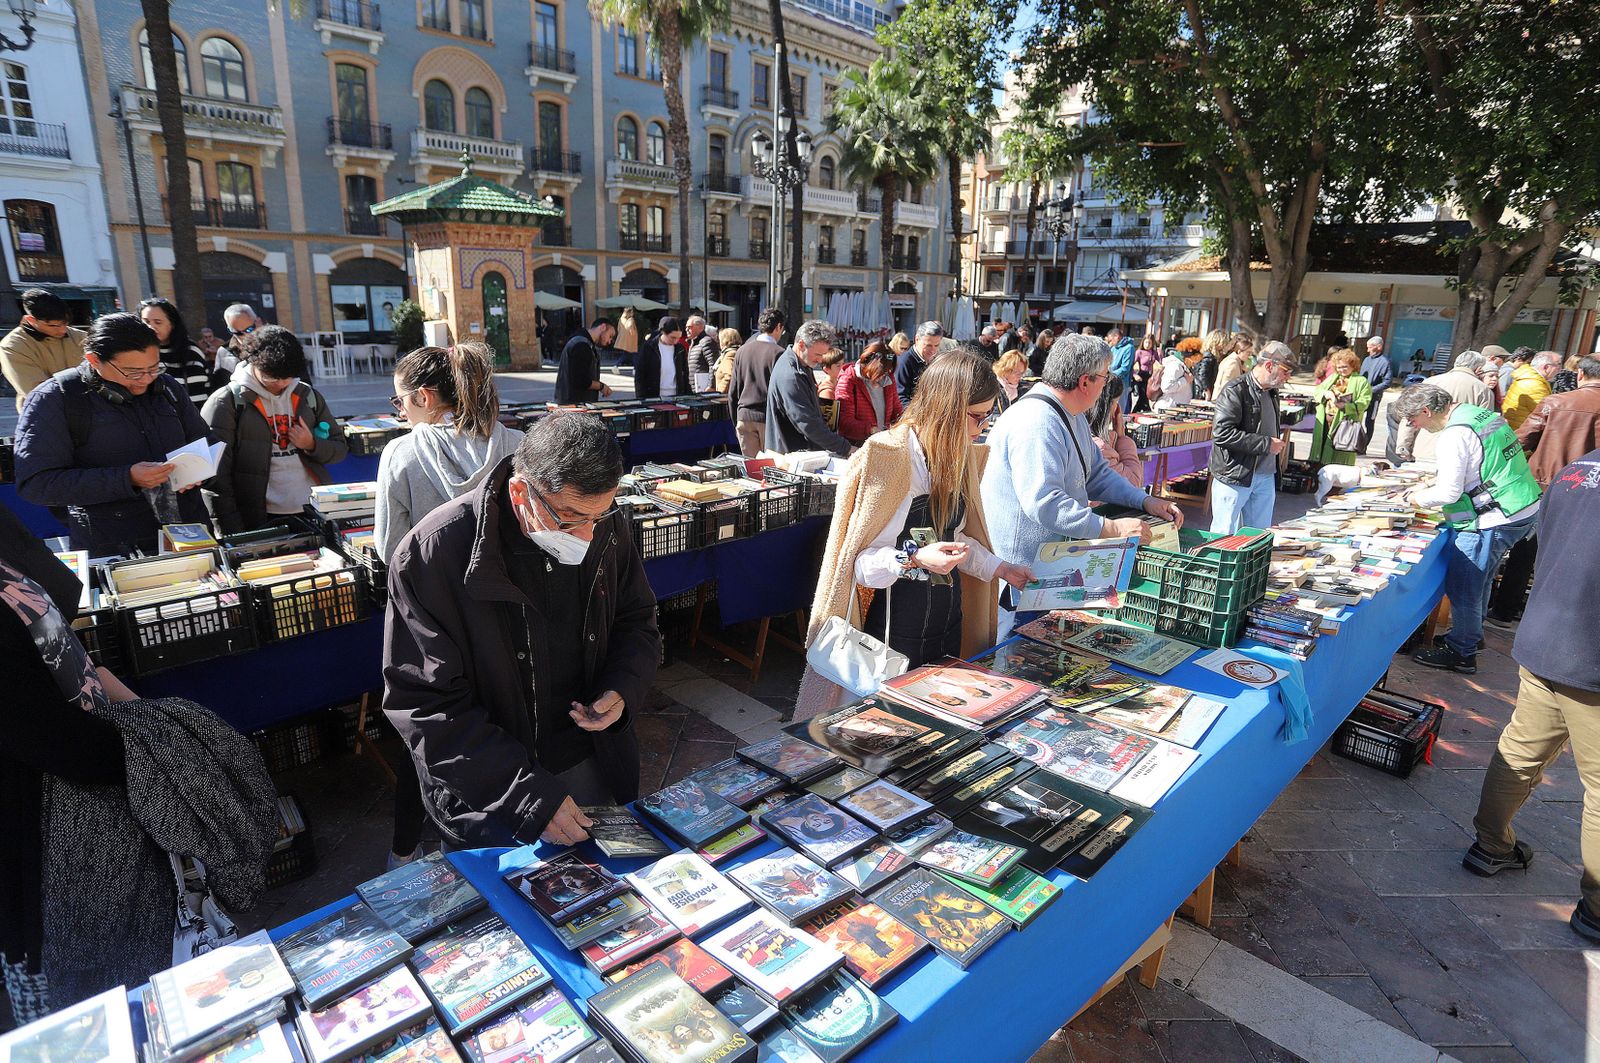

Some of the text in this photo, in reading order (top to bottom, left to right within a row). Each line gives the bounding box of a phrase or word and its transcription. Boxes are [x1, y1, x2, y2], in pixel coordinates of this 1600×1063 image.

[402, 866, 448, 891] ESPAÑA
[666, 888, 690, 904] NOW
[671, 881, 718, 910] PARADISE
[888, 882, 916, 904] VENECIA
[893, 880, 930, 909] MERCADER
[808, 894, 860, 932] U-571
[357, 944, 382, 963] CABO
[381, 937, 394, 950] EL
[341, 956, 359, 972] DEL
[685, 964, 719, 985] ÚLTIM
[309, 967, 340, 989] MIEDO
[488, 965, 544, 1003] CRÓNICAS
